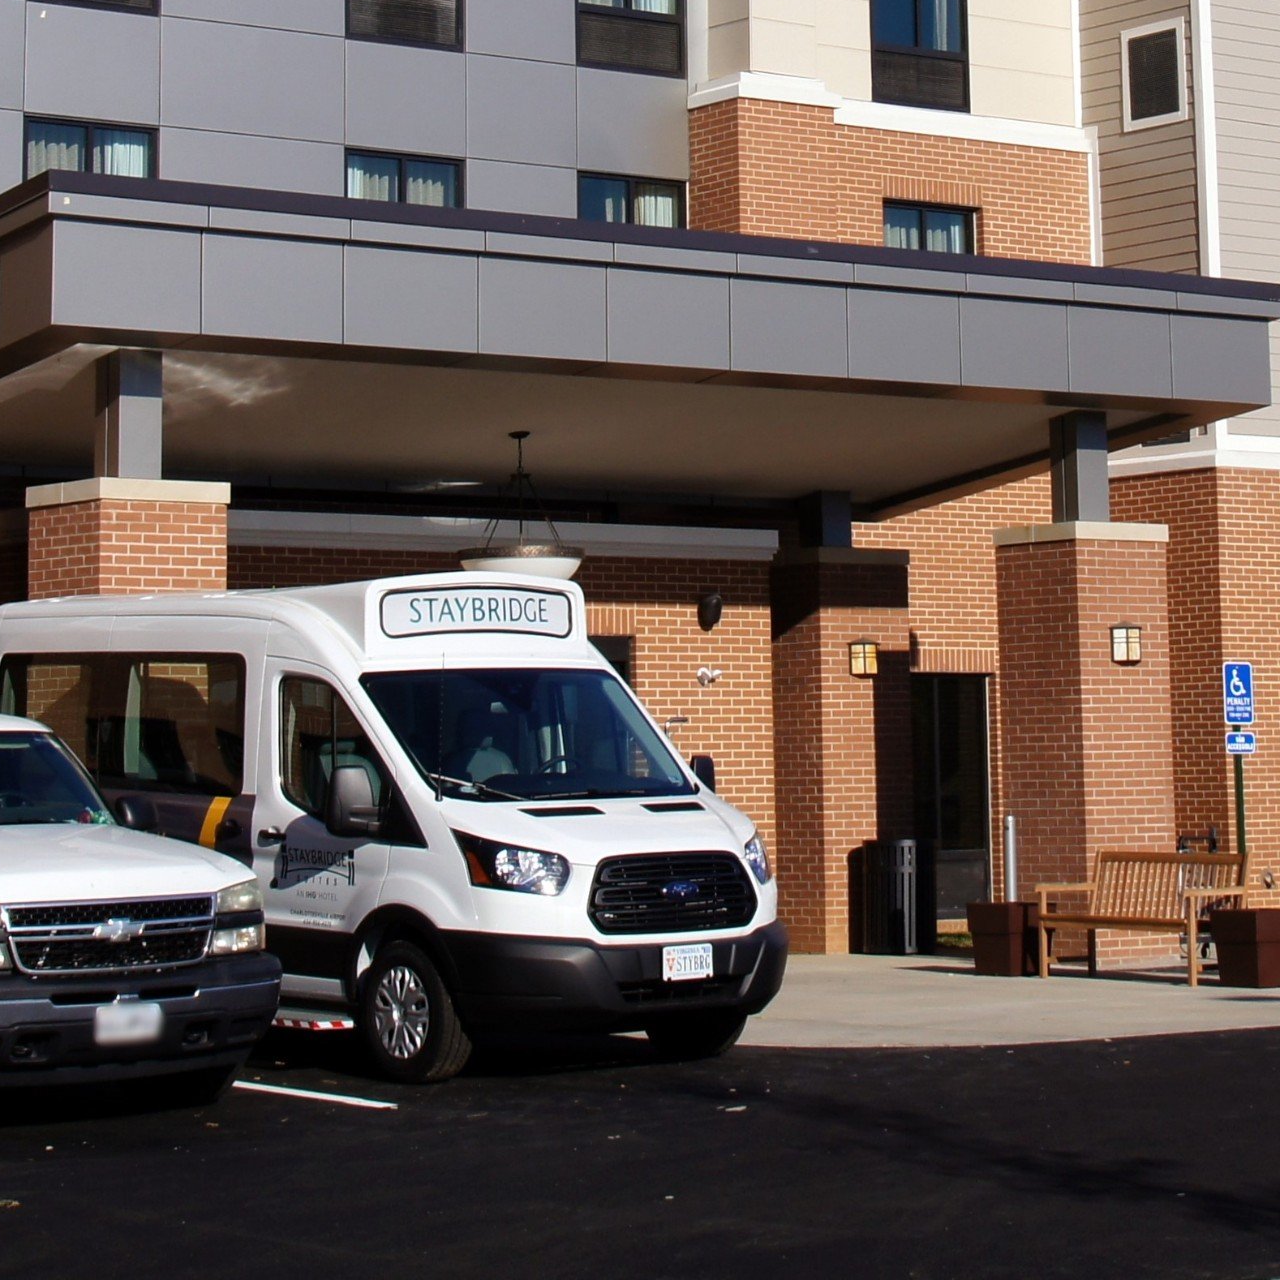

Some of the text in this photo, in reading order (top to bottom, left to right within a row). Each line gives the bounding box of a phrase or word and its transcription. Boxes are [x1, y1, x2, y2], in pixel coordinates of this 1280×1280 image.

[409, 597, 549, 624] STAYBRIDGE
[1227, 697, 1250, 705] PENALTY
[288, 848, 347, 867] STAYBRIDGE
[306, 891, 317, 899] IHG
[319, 893, 337, 901] HOTEL
[677, 955, 710, 971] STYBRG
